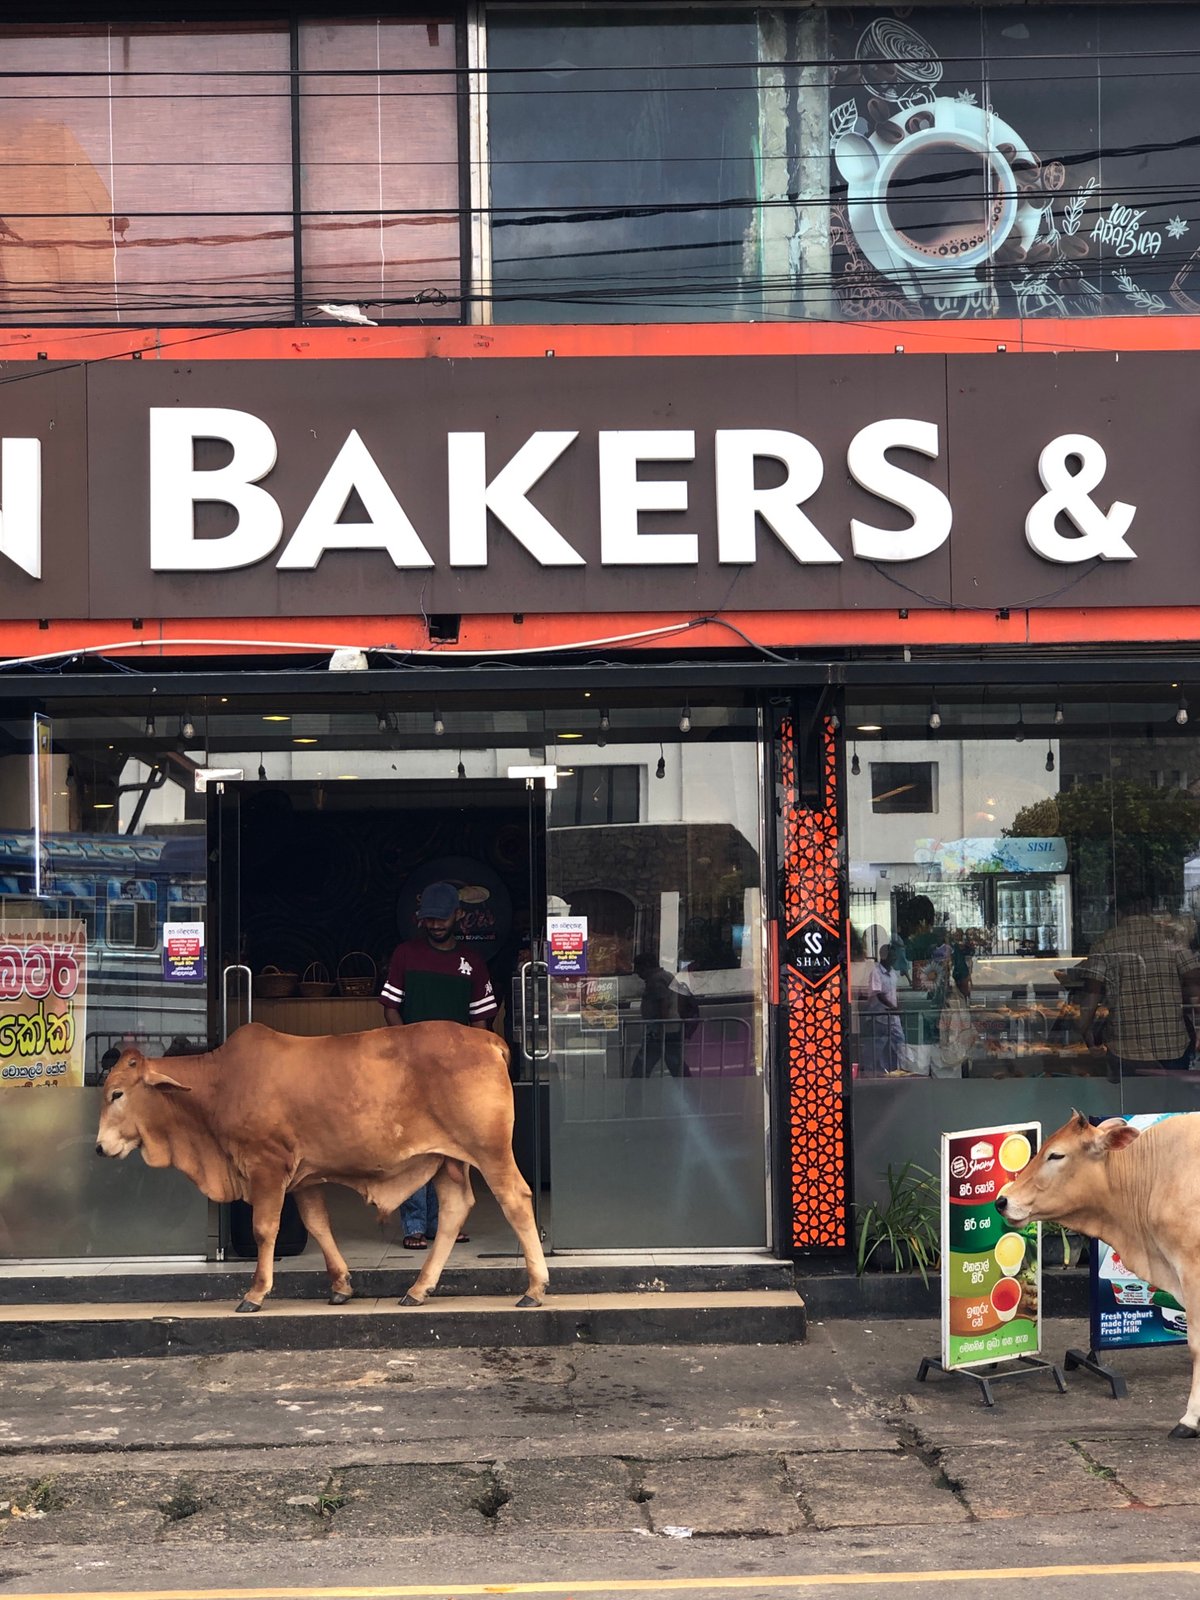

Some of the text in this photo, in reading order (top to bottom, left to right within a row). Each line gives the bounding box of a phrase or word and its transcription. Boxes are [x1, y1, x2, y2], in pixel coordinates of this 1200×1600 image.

[1106, 202, 1147, 231] 100%
[1090, 217, 1162, 258] ARABICA
[149, 406, 952, 572] BAKERS
[1024, 433, 1137, 564] &
[796, 957, 831, 967] SHAN
[1101, 1310, 1153, 1321] Fresh Yoghurt
[1101, 1326, 1140, 1335] Fresh Milk
